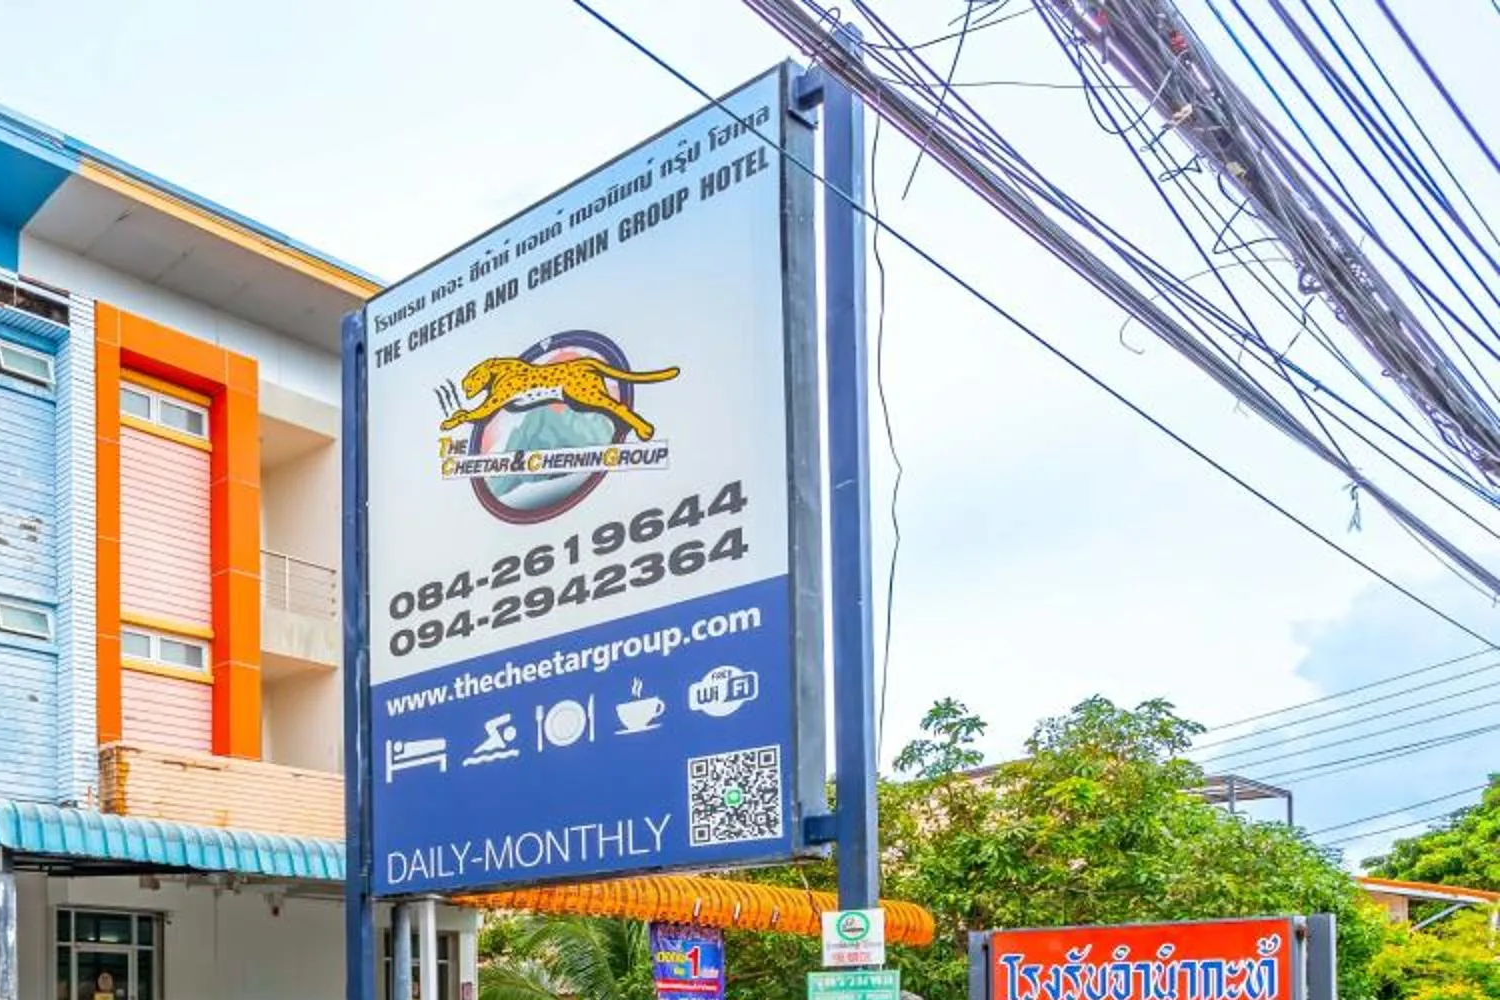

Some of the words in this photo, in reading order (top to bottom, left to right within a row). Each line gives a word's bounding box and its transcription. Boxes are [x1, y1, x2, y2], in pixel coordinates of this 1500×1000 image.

[374, 296, 426, 334] โรงแรม
[432, 276, 463, 305] เดอะ
[516, 208, 565, 258] แอนด์
[375, 339, 402, 369] THE
[408, 299, 477, 352] CHEETAR
[484, 277, 519, 314] AND
[528, 228, 609, 290] CHERNIN
[618, 187, 689, 243] GROUP
[701, 146, 770, 201] HOTEL
[438, 437, 468, 458] THE
[389, 479, 749, 621] 084-2619644
[389, 526, 749, 658] 094-2942364
[386, 606, 762, 717] www.thecheetargroup.com
[387, 813, 672, 885] DAILY-MONTHLY
